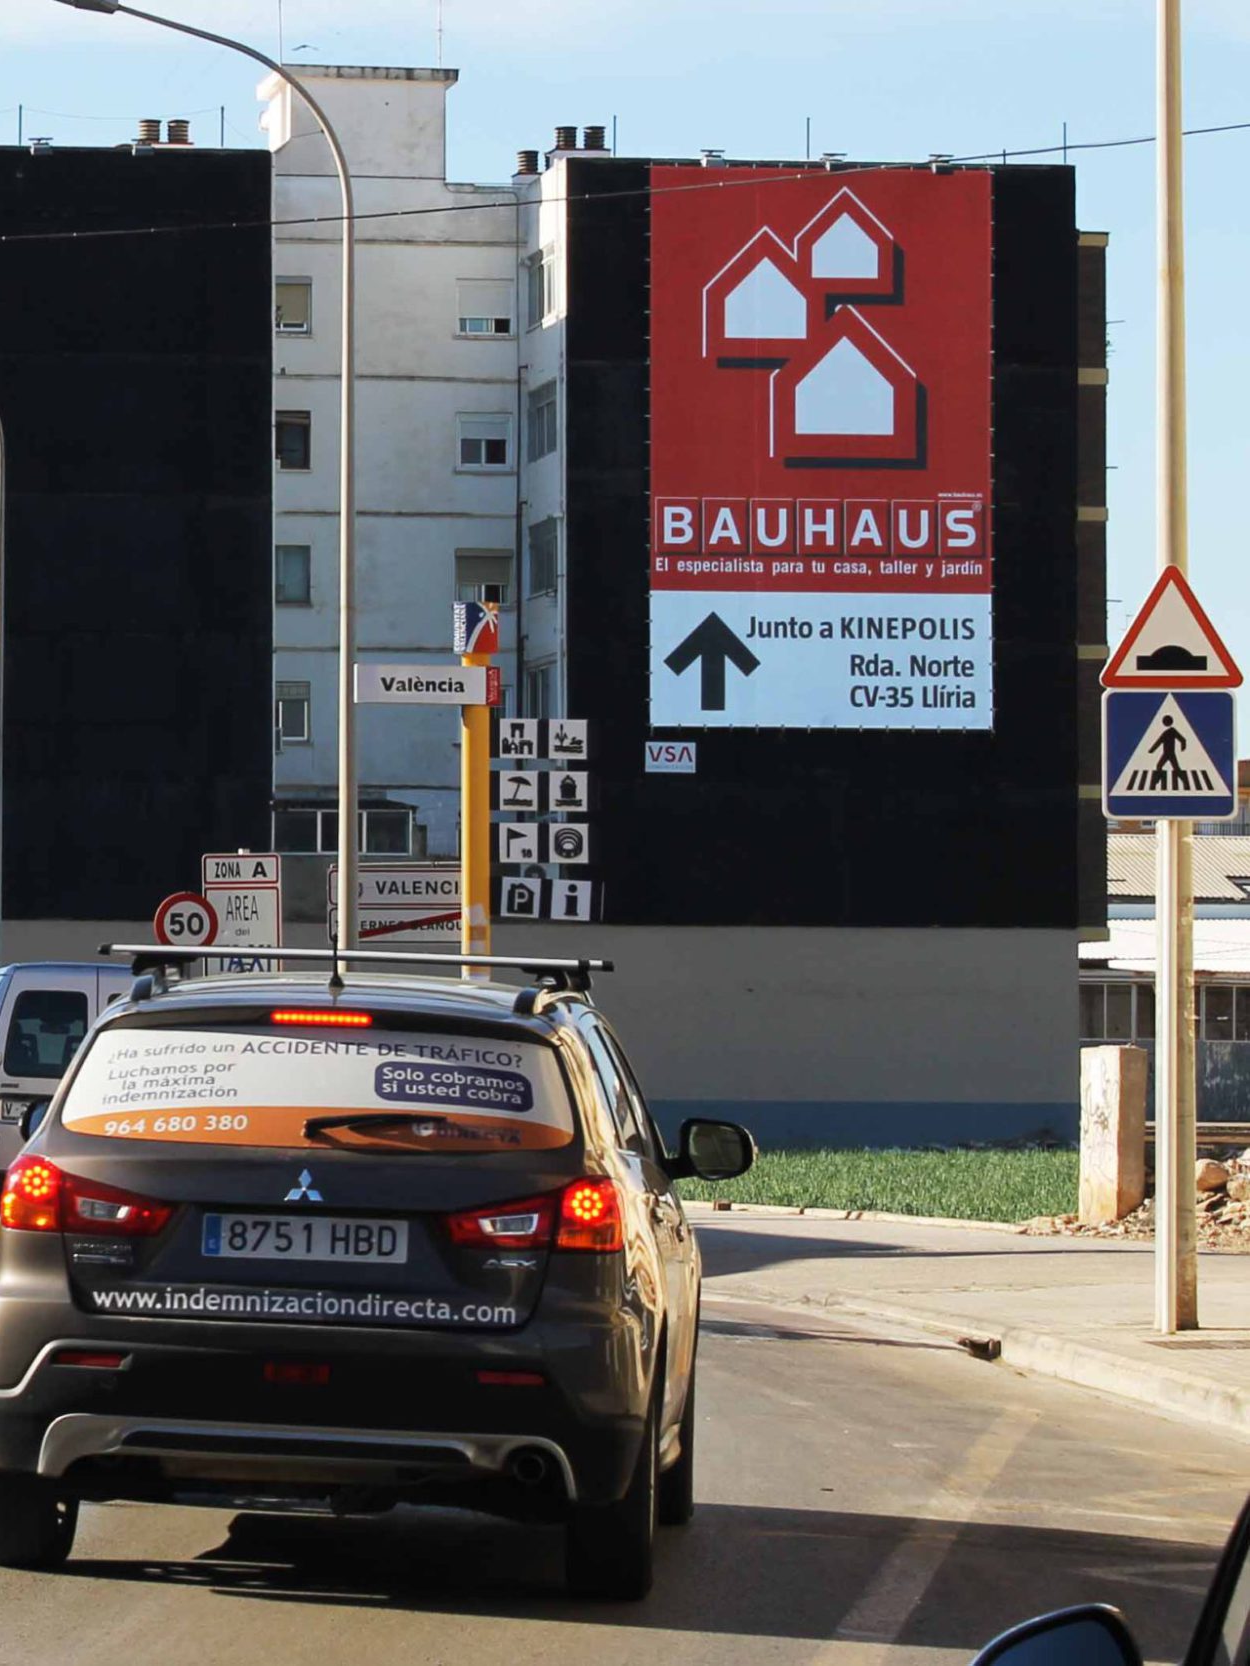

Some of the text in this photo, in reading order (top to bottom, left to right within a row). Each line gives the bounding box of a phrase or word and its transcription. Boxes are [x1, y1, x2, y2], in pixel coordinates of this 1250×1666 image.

[663, 506, 977, 549] BAUHAUS
[655, 557, 983, 578] El especialista para tu casa, taller y jardín
[746, 616, 975, 640] Junto a KINEPOLIS
[850, 653, 974, 677] Rda. Norte
[380, 676, 465, 693] València
[850, 685, 976, 708] CV-35 Llíria
[648, 745, 693, 763] VSA
[214, 861, 268, 878] ZONA A
[375, 880, 461, 895] VALENCI
[226, 895, 259, 921] AREA
[170, 912, 204, 936] 50
[235, 928, 250, 936] del
[107, 1041, 523, 1068] ¿Ha sufrido un ACCIDENTE DE TRÁFICO?
[108, 1063, 236, 1080] Luchamos por
[382, 1067, 525, 1092] Solo cobramos
[122, 1075, 216, 1090] la máxima
[102, 1085, 238, 1105] indemnización
[405, 1083, 461, 1098] usted
[467, 1088, 522, 1104] cobra
[104, 1115, 248, 1136] 964 680 380
[227, 1220, 313, 1253] 8751
[330, 1222, 397, 1257] HBD
[482, 1258, 537, 1270] ASX
[93, 1287, 516, 1324] www.indemnizaciondirecta.com
